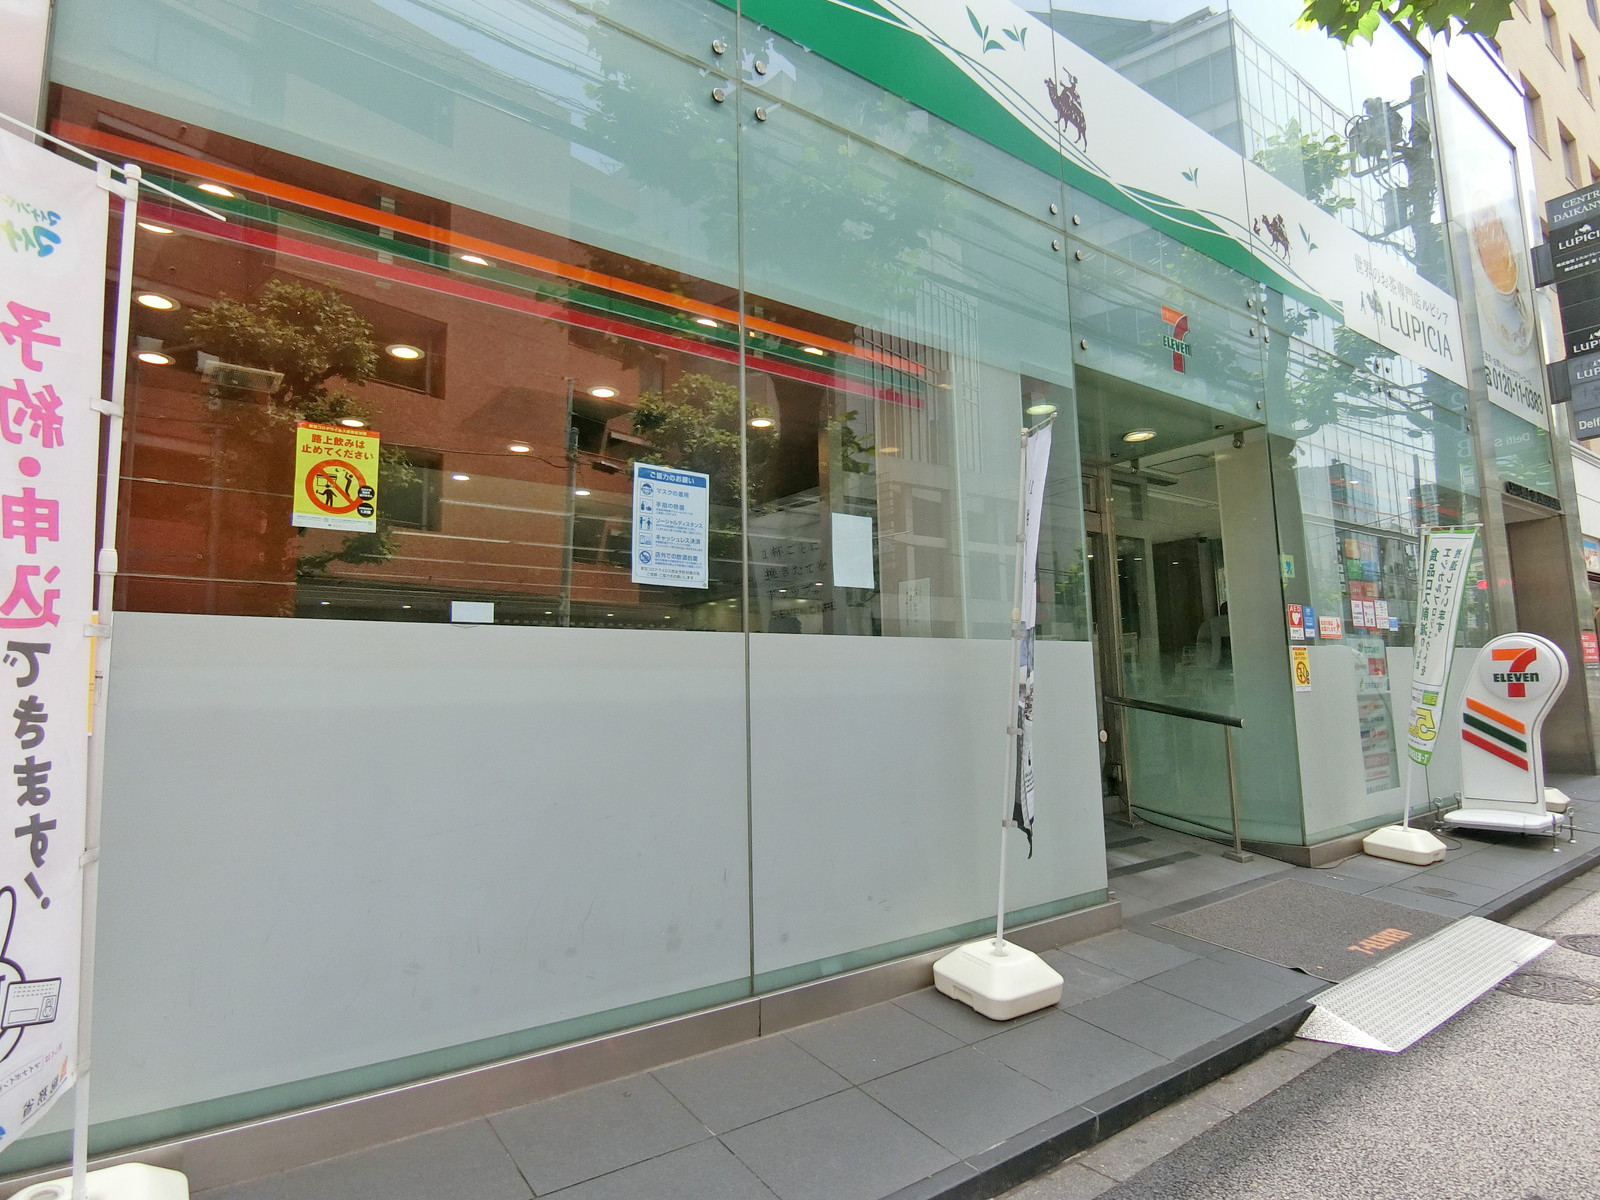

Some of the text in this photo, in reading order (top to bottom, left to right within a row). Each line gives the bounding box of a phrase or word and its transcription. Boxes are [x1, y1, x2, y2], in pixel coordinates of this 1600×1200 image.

[1387, 300, 1454, 362] LUPICIA
[1492, 366, 1544, 416] 0120-11-0383
[311, 434, 365, 449] 路上飲みは
[301, 443, 374, 460] 止めてください
[650, 471, 695, 484] ご協力のお願い
[657, 488, 690, 498] マスクの着用
[656, 518, 703, 529] ソーシャルディスタンス
[656, 535, 701, 545] キャッシュレス決済
[1289, 605, 1302, 613] AED
[1491, 647, 1537, 698] 7
